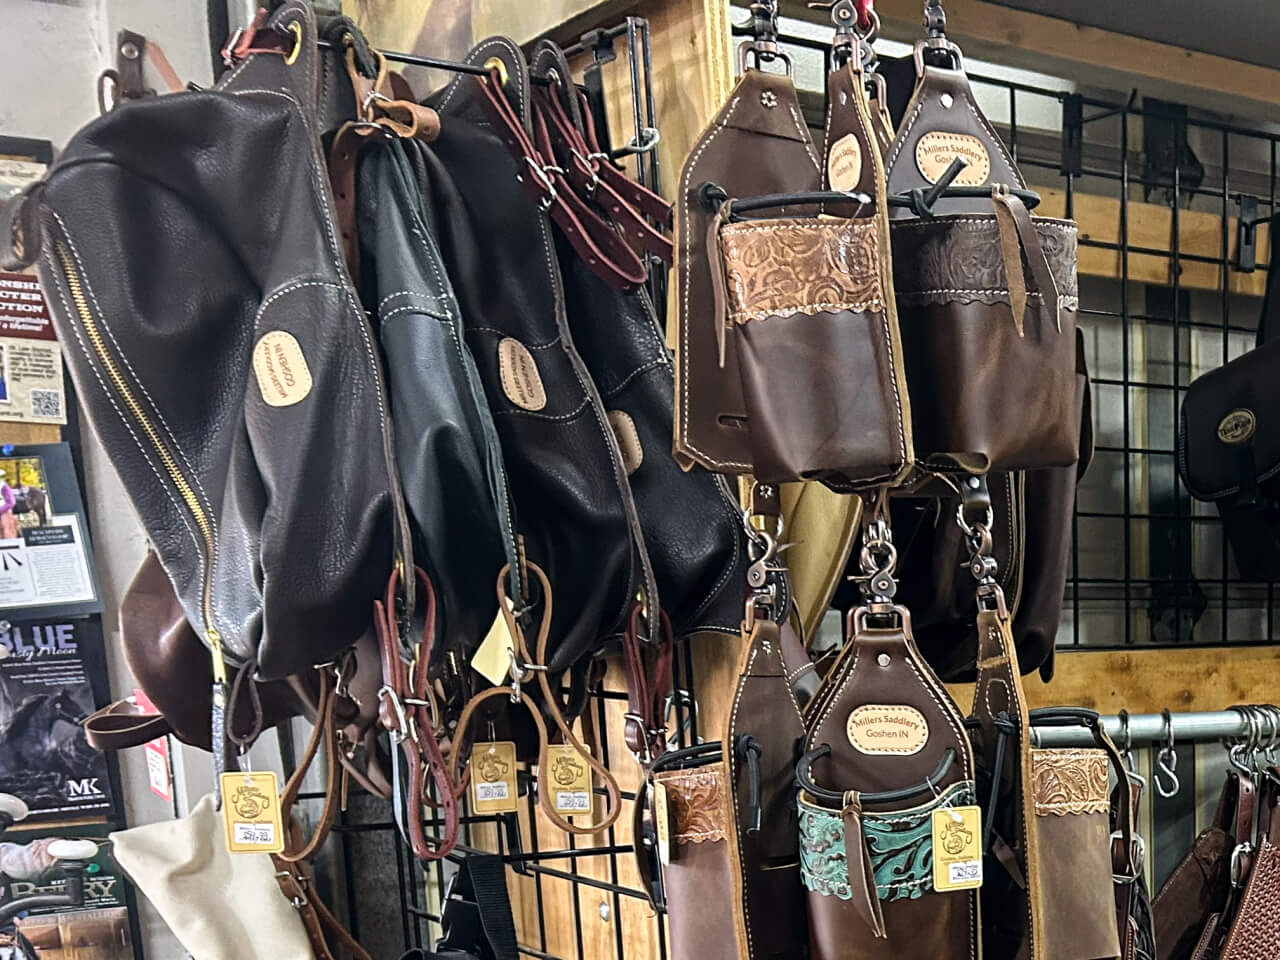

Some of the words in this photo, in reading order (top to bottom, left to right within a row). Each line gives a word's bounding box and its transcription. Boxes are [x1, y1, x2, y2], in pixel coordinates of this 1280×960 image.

[923, 144, 949, 156] Millers
[950, 144, 983, 161] Saddlery
[854, 715, 882, 728] Millers
[883, 715, 920, 730] Saddlery
[865, 729, 897, 738] Goshen
[898, 730, 909, 739] IN
[67, 778, 102, 797] MK
